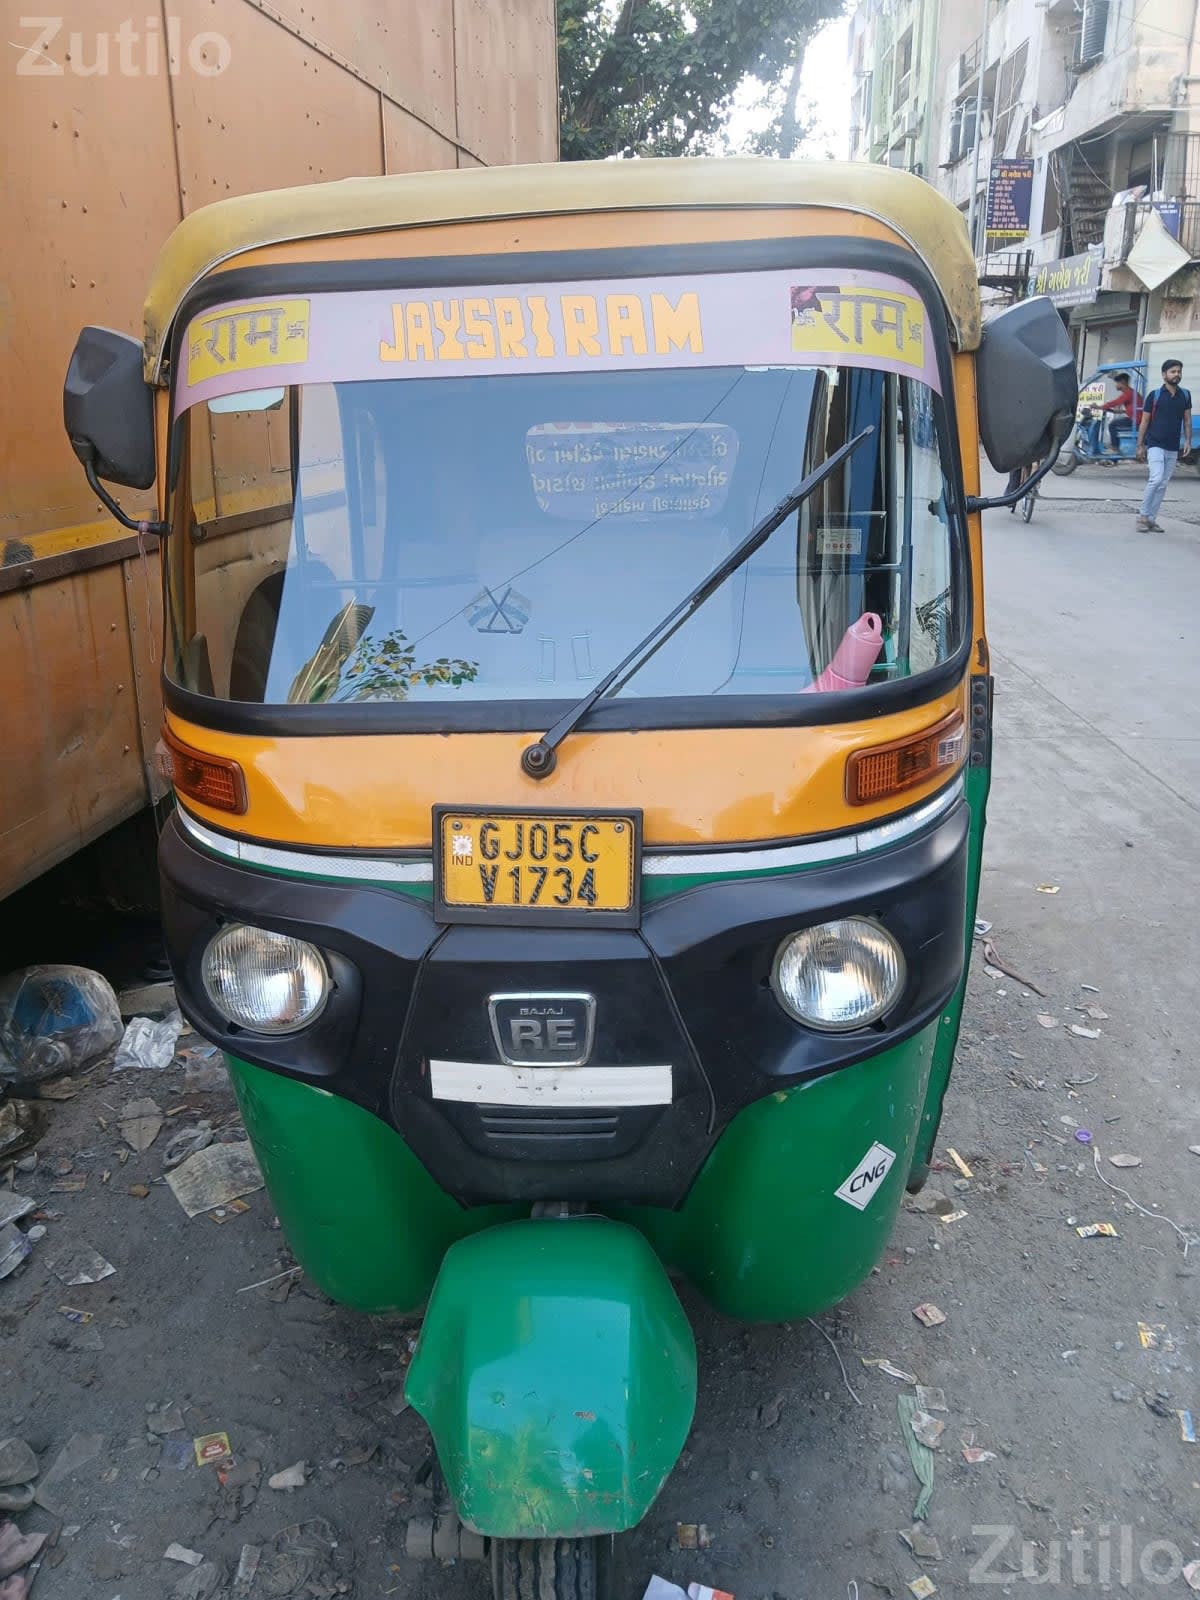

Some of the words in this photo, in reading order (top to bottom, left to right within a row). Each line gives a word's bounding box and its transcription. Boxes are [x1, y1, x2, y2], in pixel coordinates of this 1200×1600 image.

[200, 307, 286, 364] राम
[814, 291, 906, 352] राम
[452, 855, 473, 867] IND
[479, 822, 599, 863] GJ05C
[479, 864, 597, 905] V1734
[519, 1007, 564, 1016] BAJAJ
[510, 1018, 577, 1051] RE
[850, 1158, 887, 1193] CNG
